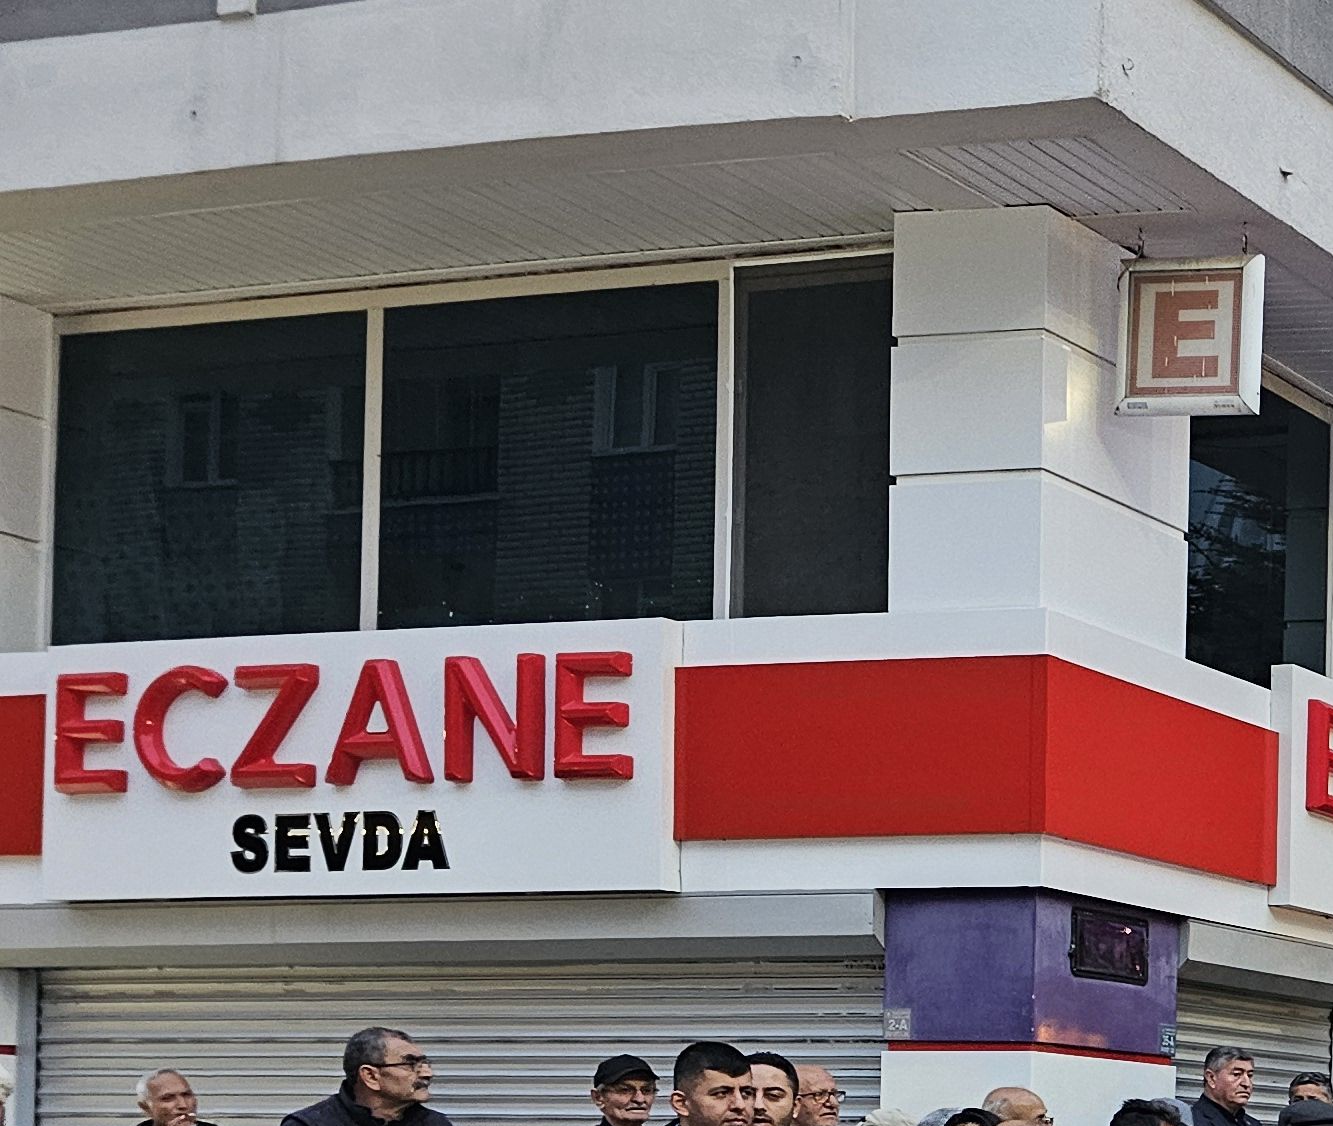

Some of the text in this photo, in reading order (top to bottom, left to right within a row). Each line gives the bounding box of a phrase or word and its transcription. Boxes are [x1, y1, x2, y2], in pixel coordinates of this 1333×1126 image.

[1152, 290, 1219, 379] E
[55, 651, 635, 795] ECZANE
[231, 809, 450, 874] SEVDA
